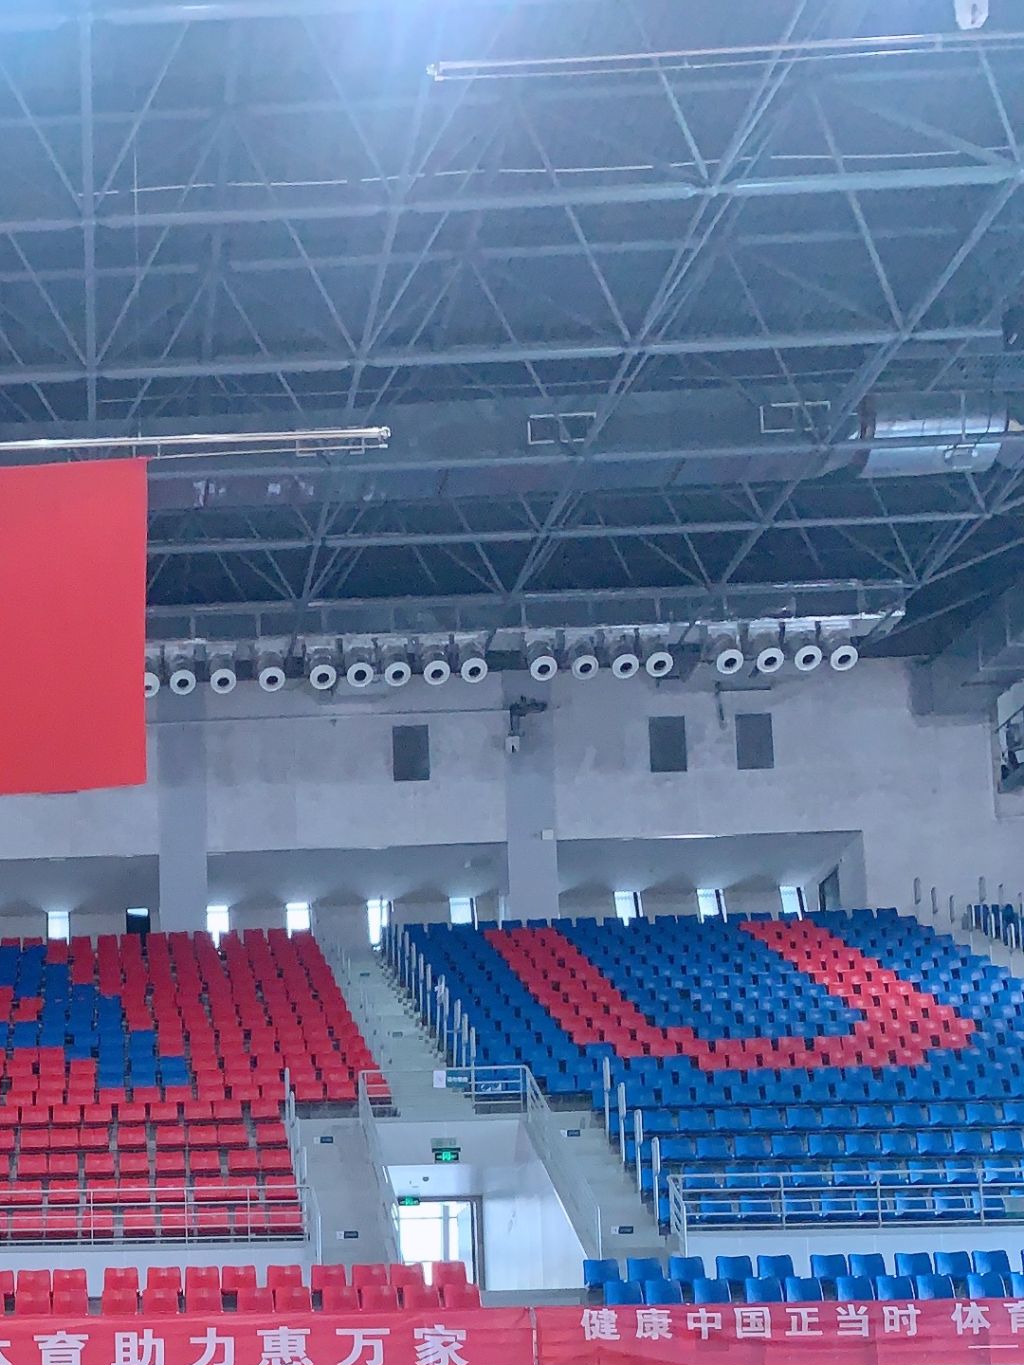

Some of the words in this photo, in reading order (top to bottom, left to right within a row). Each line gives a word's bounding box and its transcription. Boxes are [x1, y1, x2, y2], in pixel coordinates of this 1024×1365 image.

[580, 1303, 921, 1341] 健康中国正当时
